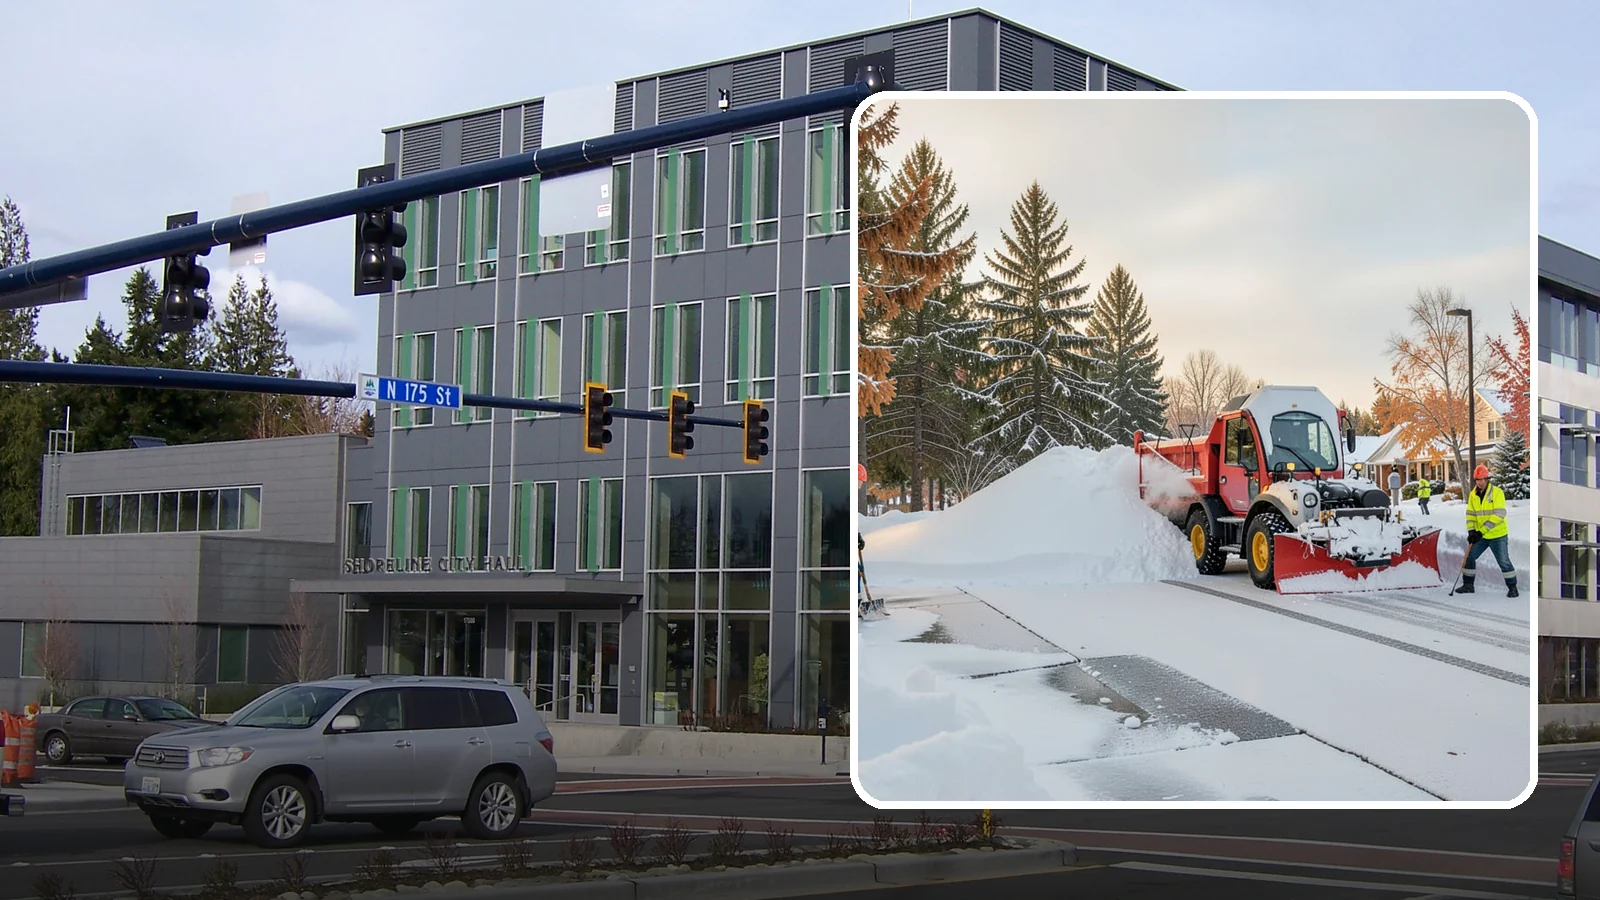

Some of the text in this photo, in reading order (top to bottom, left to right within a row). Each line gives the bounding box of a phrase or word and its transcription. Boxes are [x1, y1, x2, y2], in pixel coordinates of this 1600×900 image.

[387, 380, 451, 406] N 175 St
[344, 556, 525, 574] SHORELINE CITY HALL
